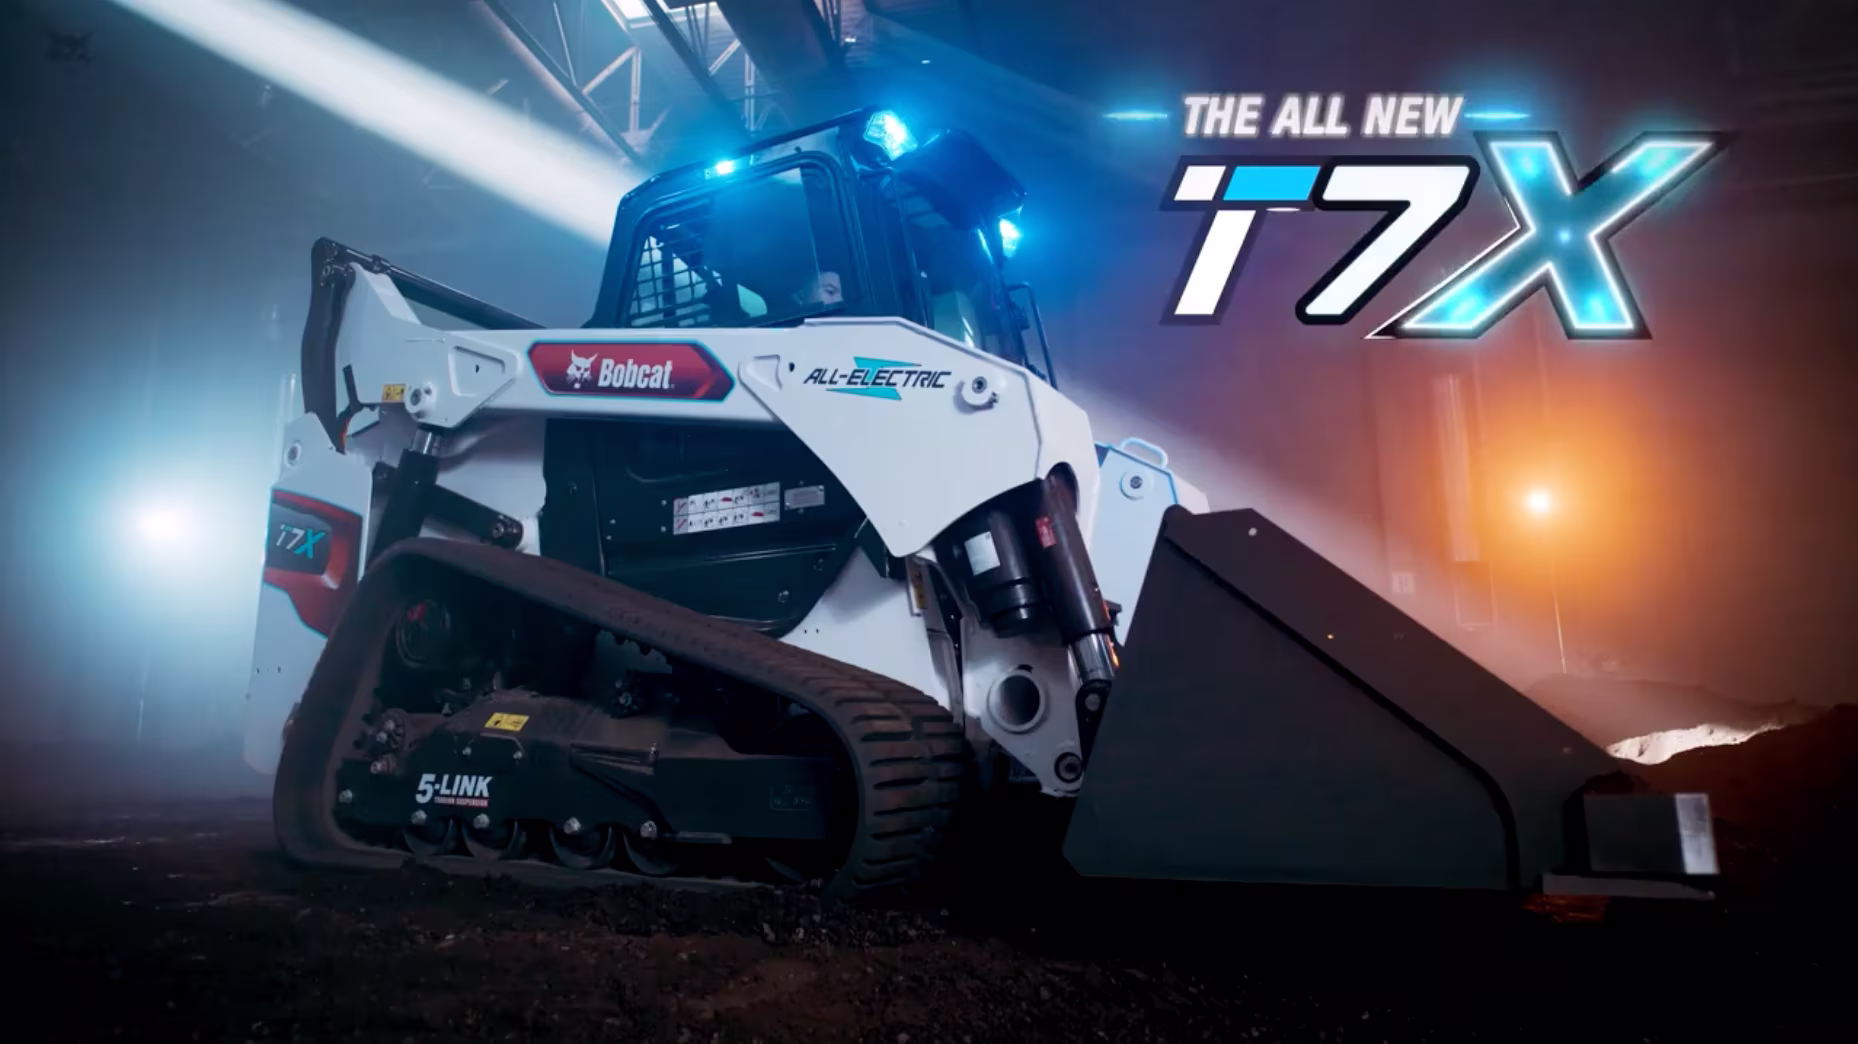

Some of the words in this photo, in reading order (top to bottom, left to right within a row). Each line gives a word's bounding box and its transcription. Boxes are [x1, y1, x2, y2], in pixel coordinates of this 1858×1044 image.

[598, 358, 674, 389] Bobcat
[803, 368, 952, 389] ALL-ELECTRIC
[276, 523, 326, 559] T7X
[415, 773, 493, 804] 5-LINK
